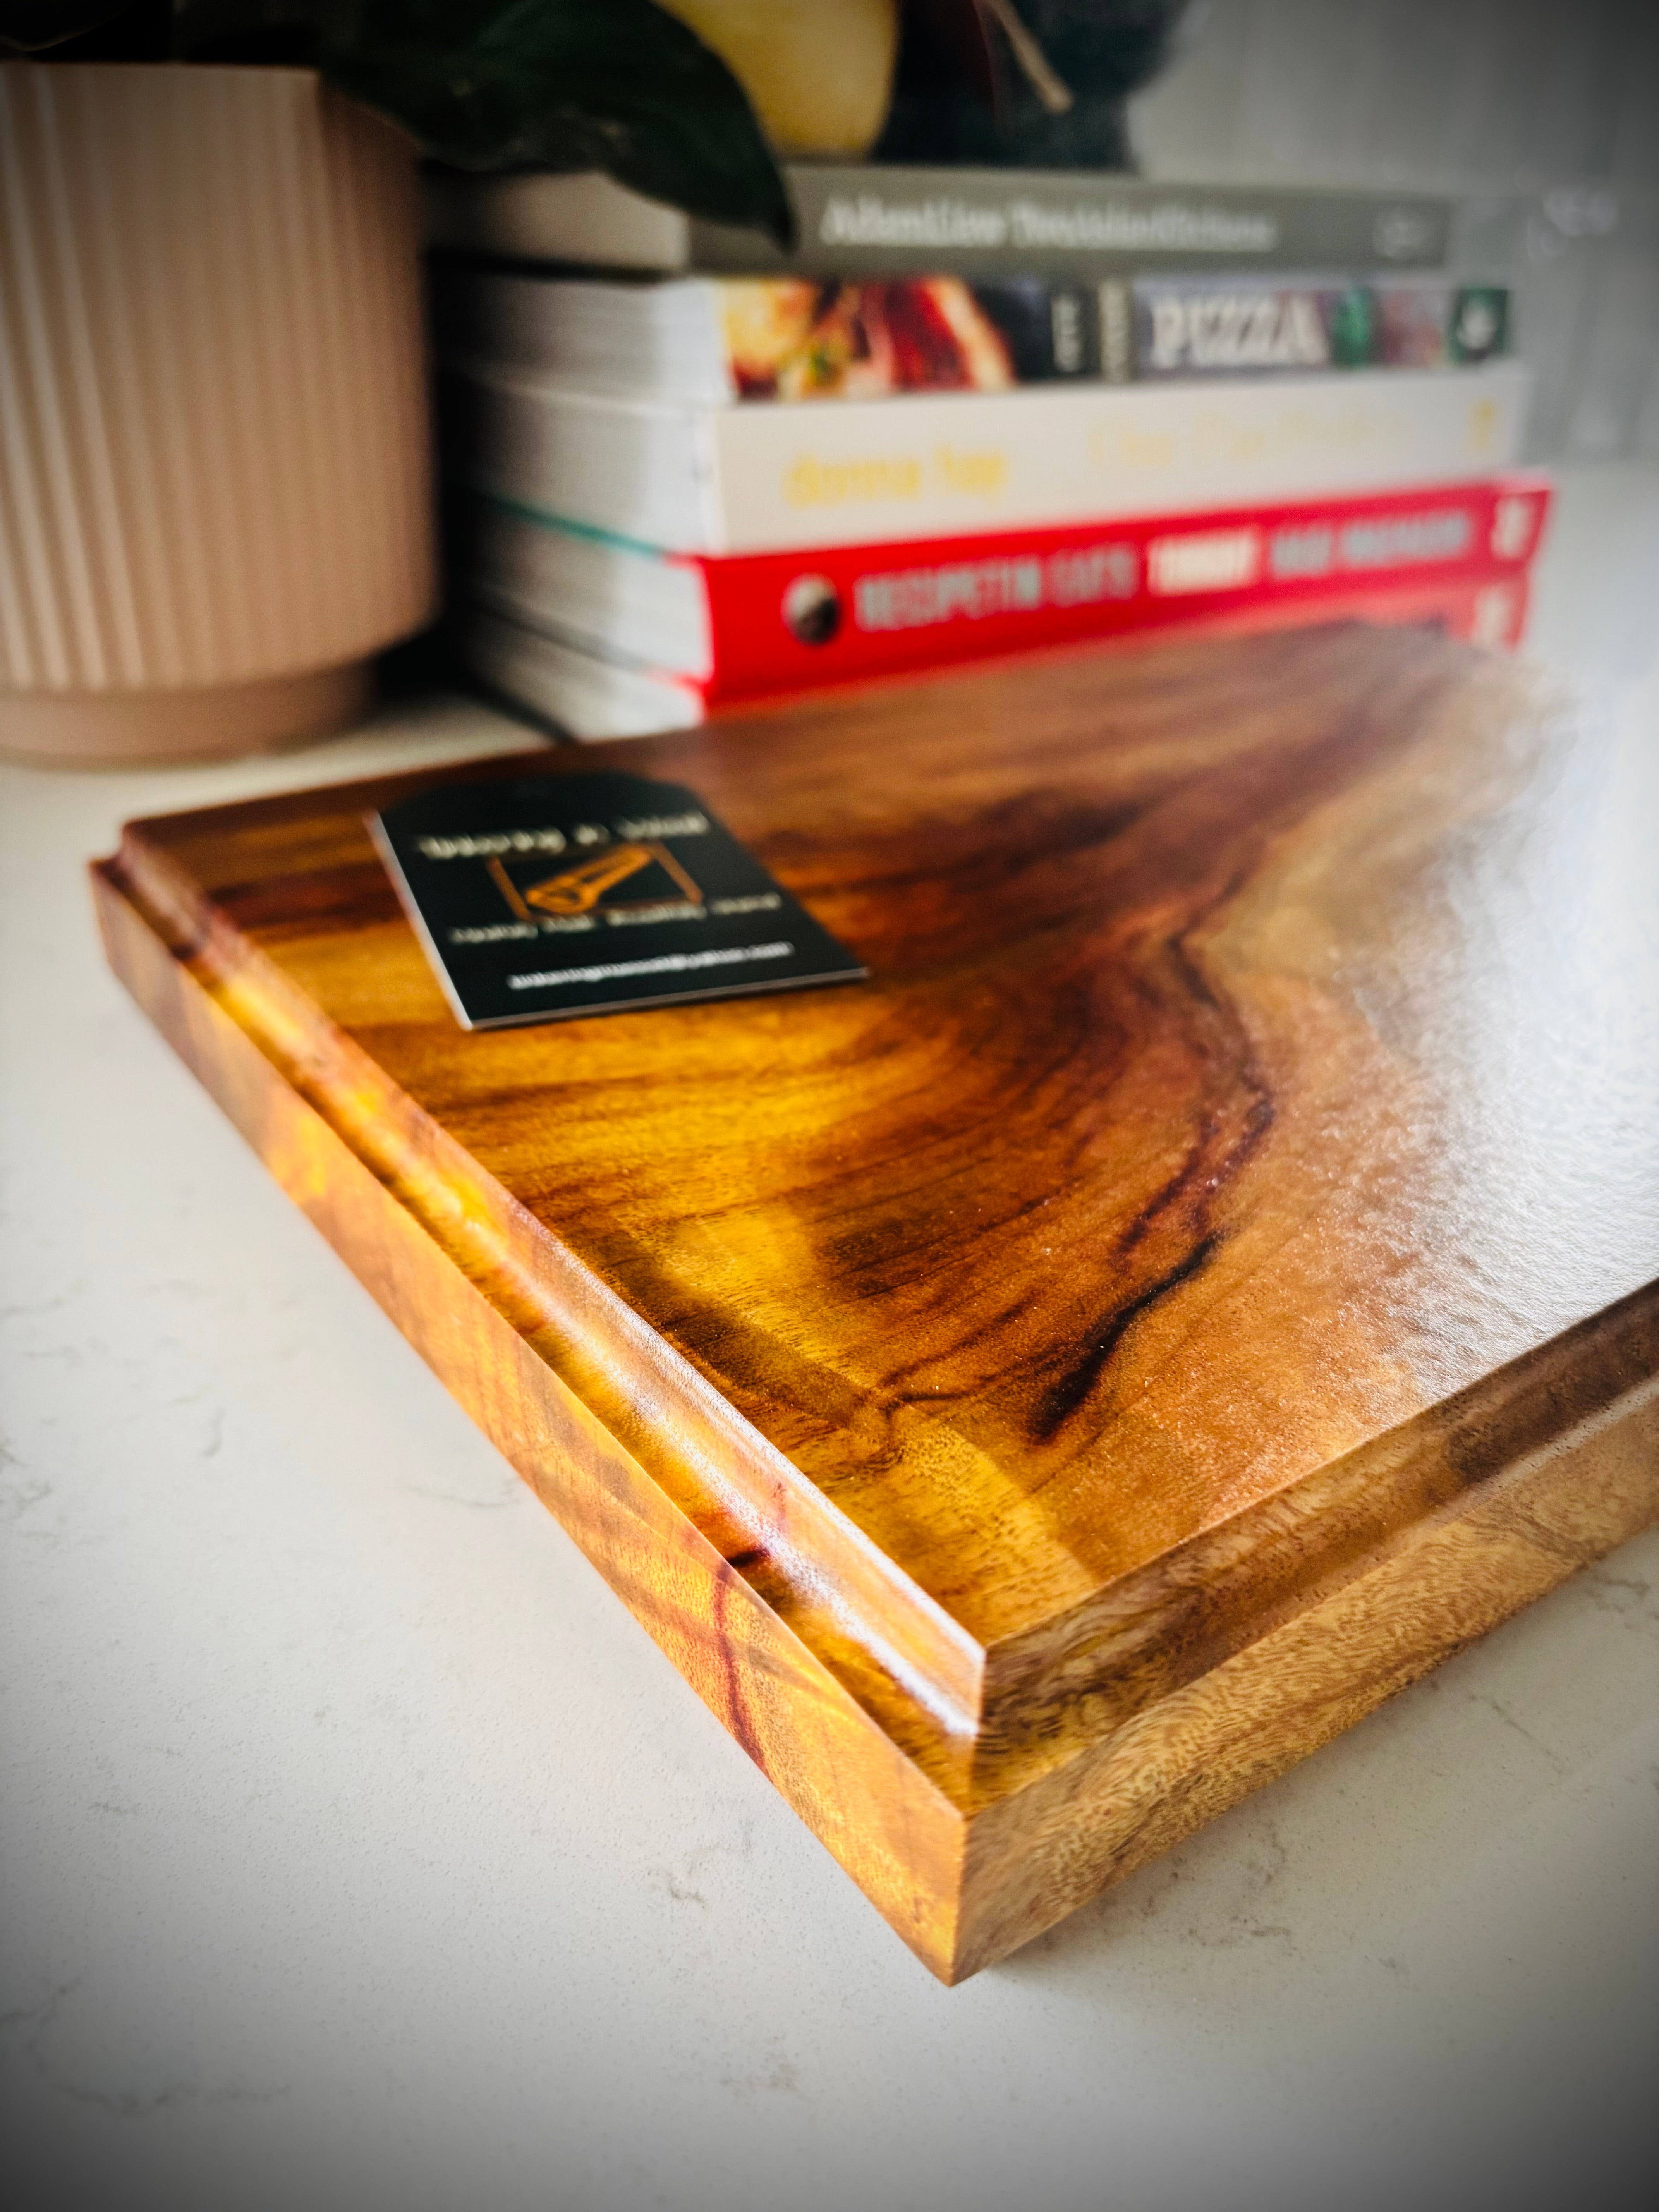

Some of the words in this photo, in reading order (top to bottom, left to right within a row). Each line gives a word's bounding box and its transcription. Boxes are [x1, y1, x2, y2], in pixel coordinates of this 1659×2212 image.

[1151, 296, 1329, 369] PIZZA
[778, 451, 925, 510] donna
[854, 554, 1042, 633] RECIPETIN
[1047, 543, 1139, 607] EATS
